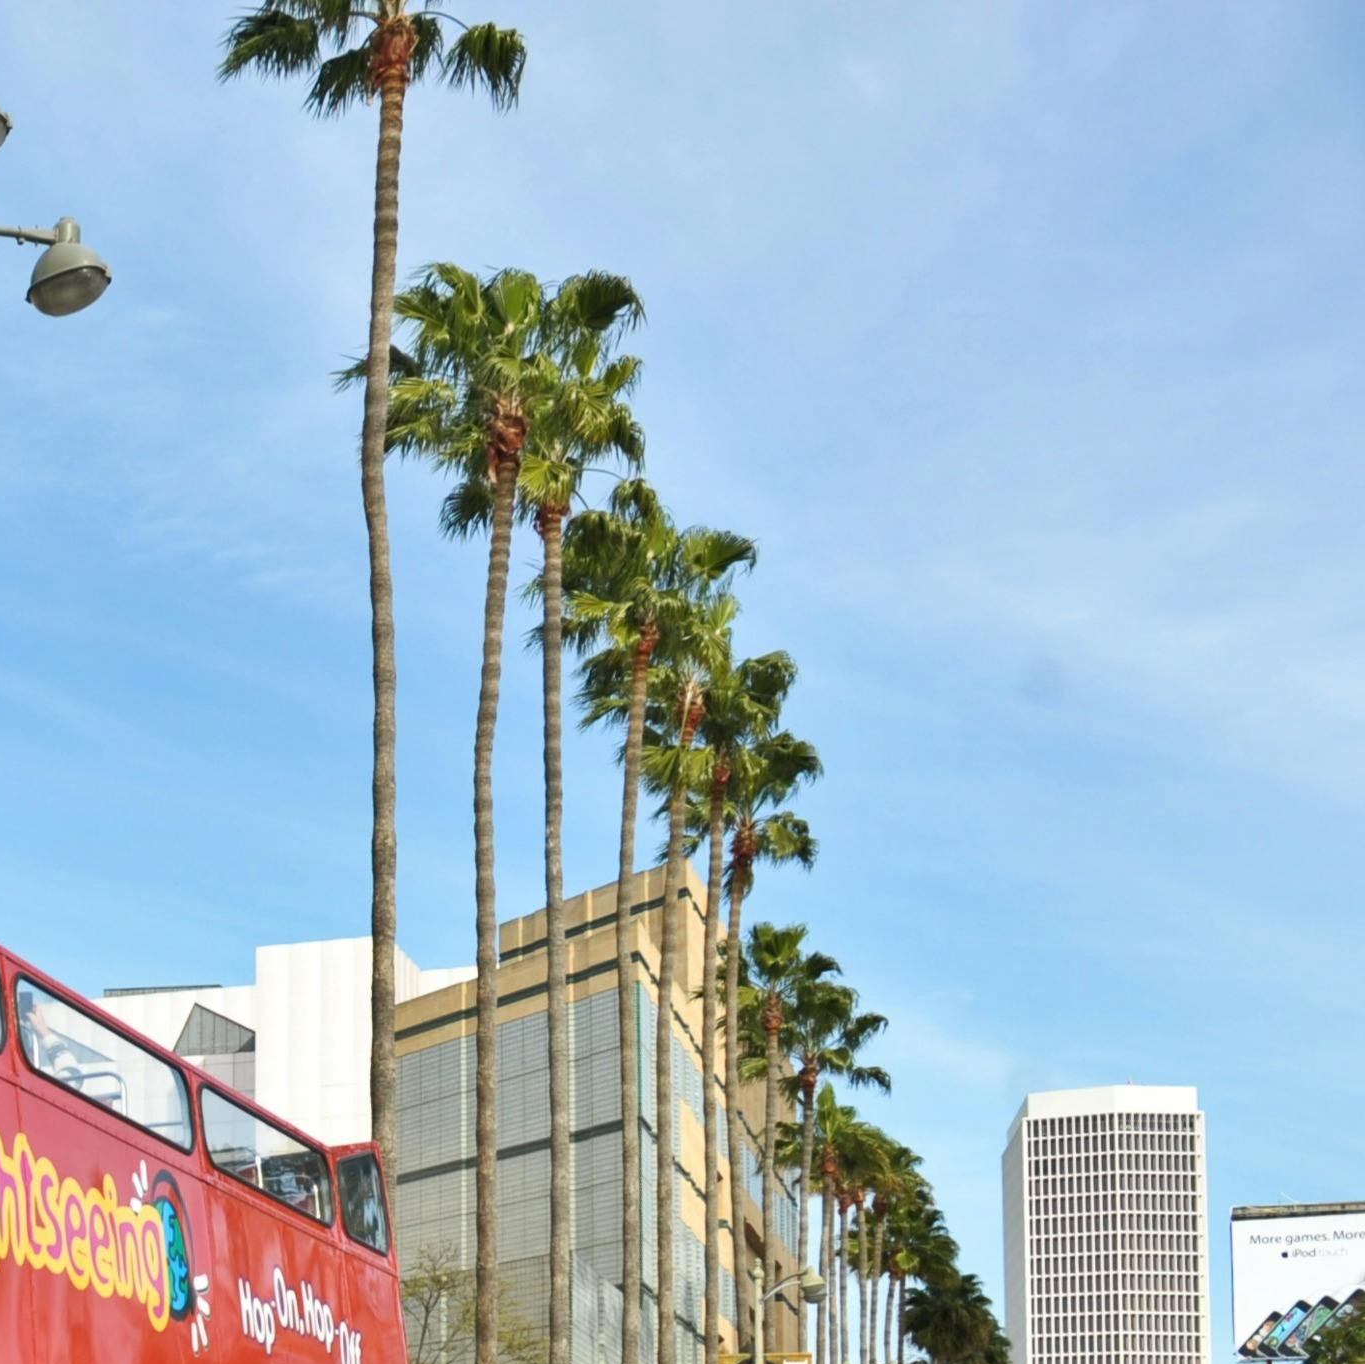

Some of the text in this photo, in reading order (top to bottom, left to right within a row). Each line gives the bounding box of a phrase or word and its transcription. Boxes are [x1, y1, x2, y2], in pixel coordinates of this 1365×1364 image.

[1249, 1229, 1365, 1246] More games. More
[1291, 1247, 1316, 1258] iPod
